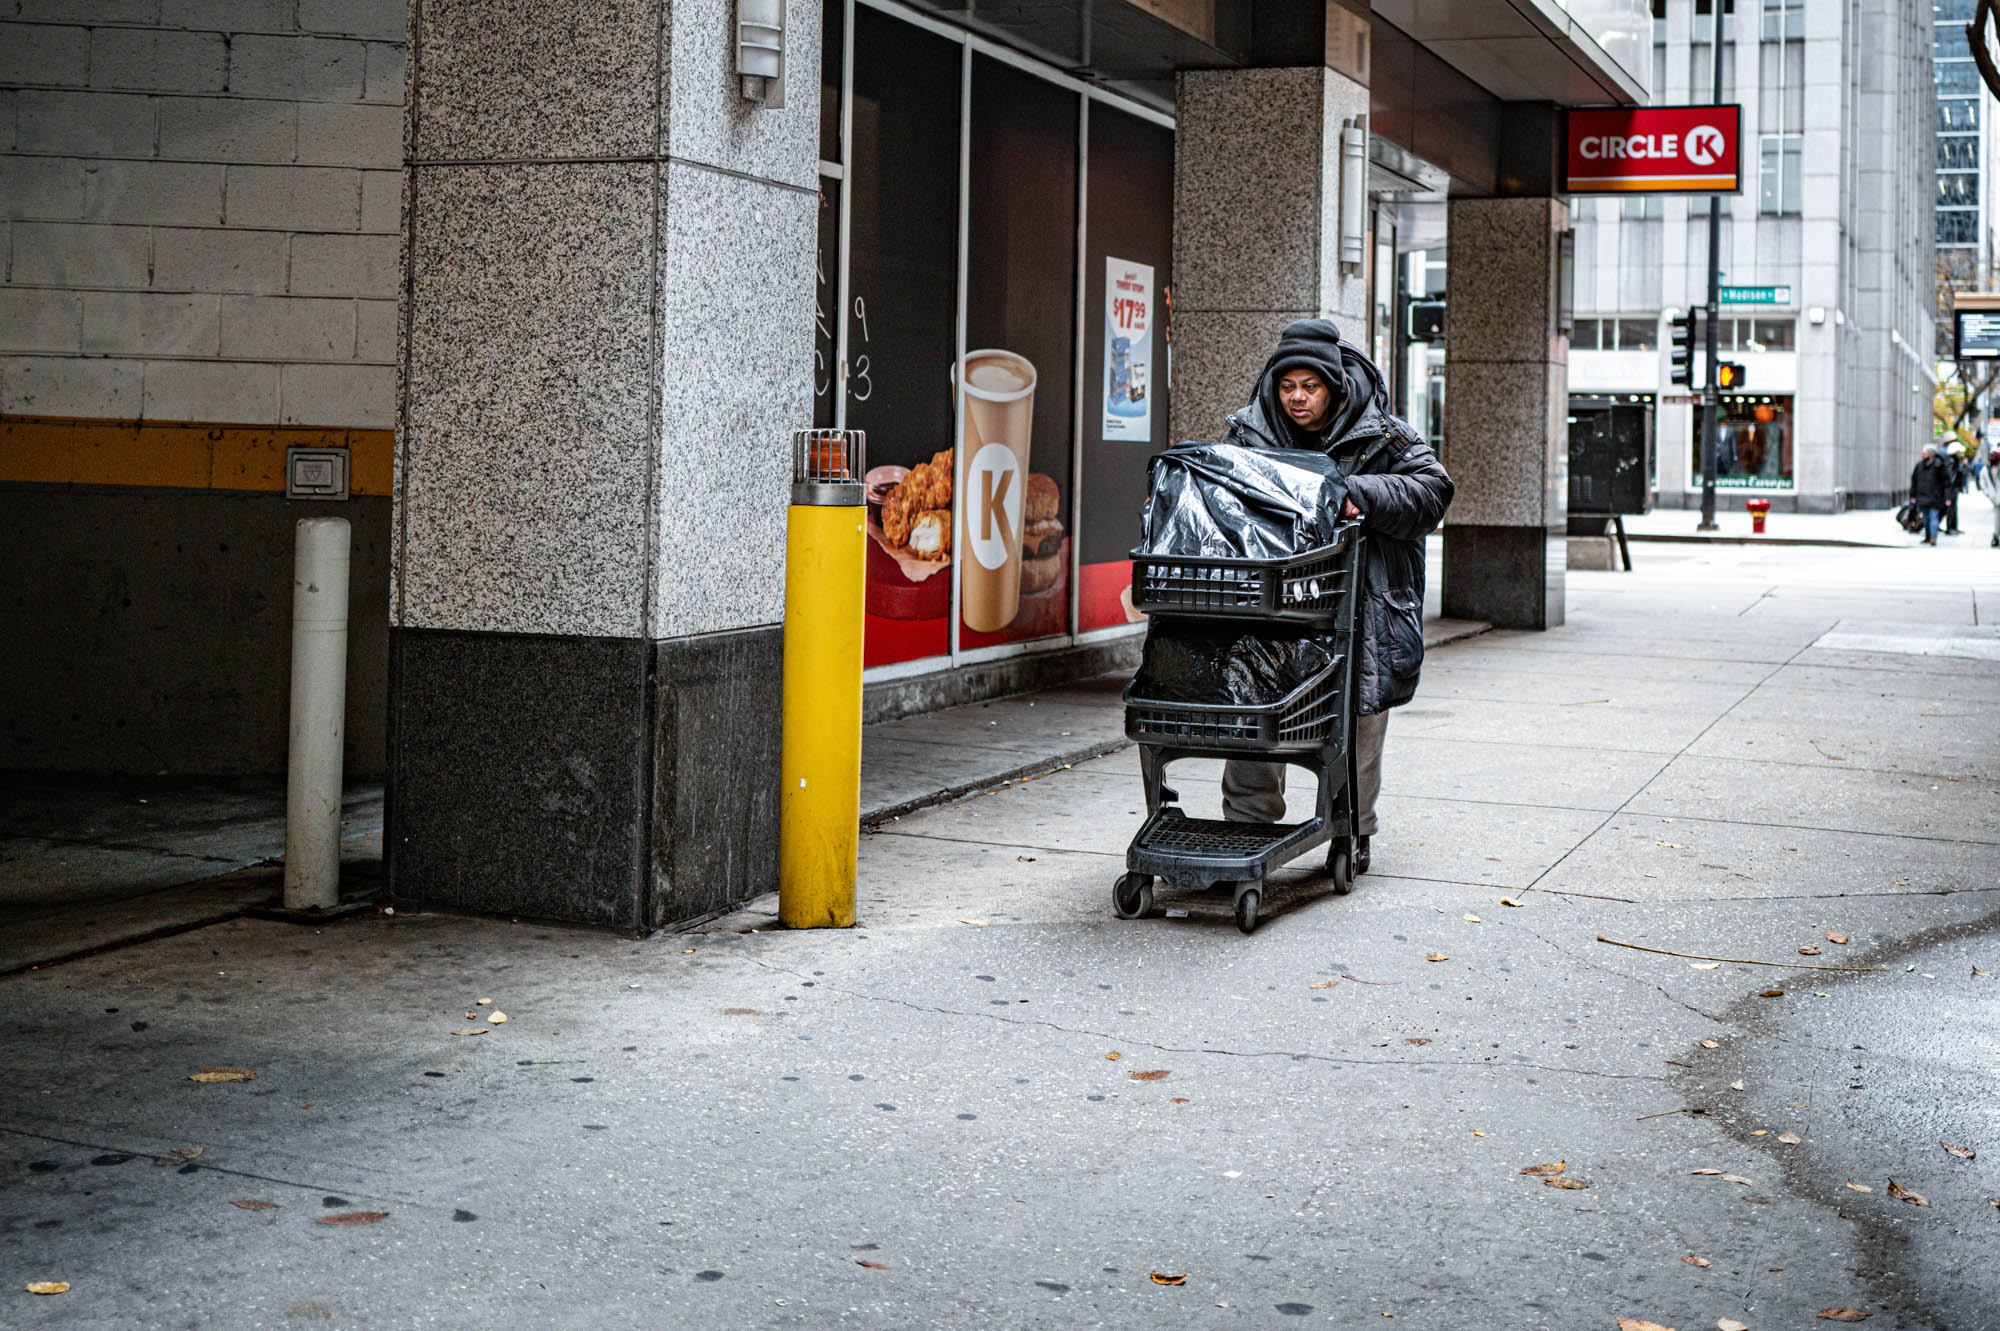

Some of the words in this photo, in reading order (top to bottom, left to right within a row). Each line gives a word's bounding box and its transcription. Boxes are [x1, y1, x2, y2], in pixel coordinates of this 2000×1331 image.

[1579, 134, 1678, 159] CIRCLE
[1694, 132, 1723, 164] K
[1729, 289, 1767, 300] Madison
